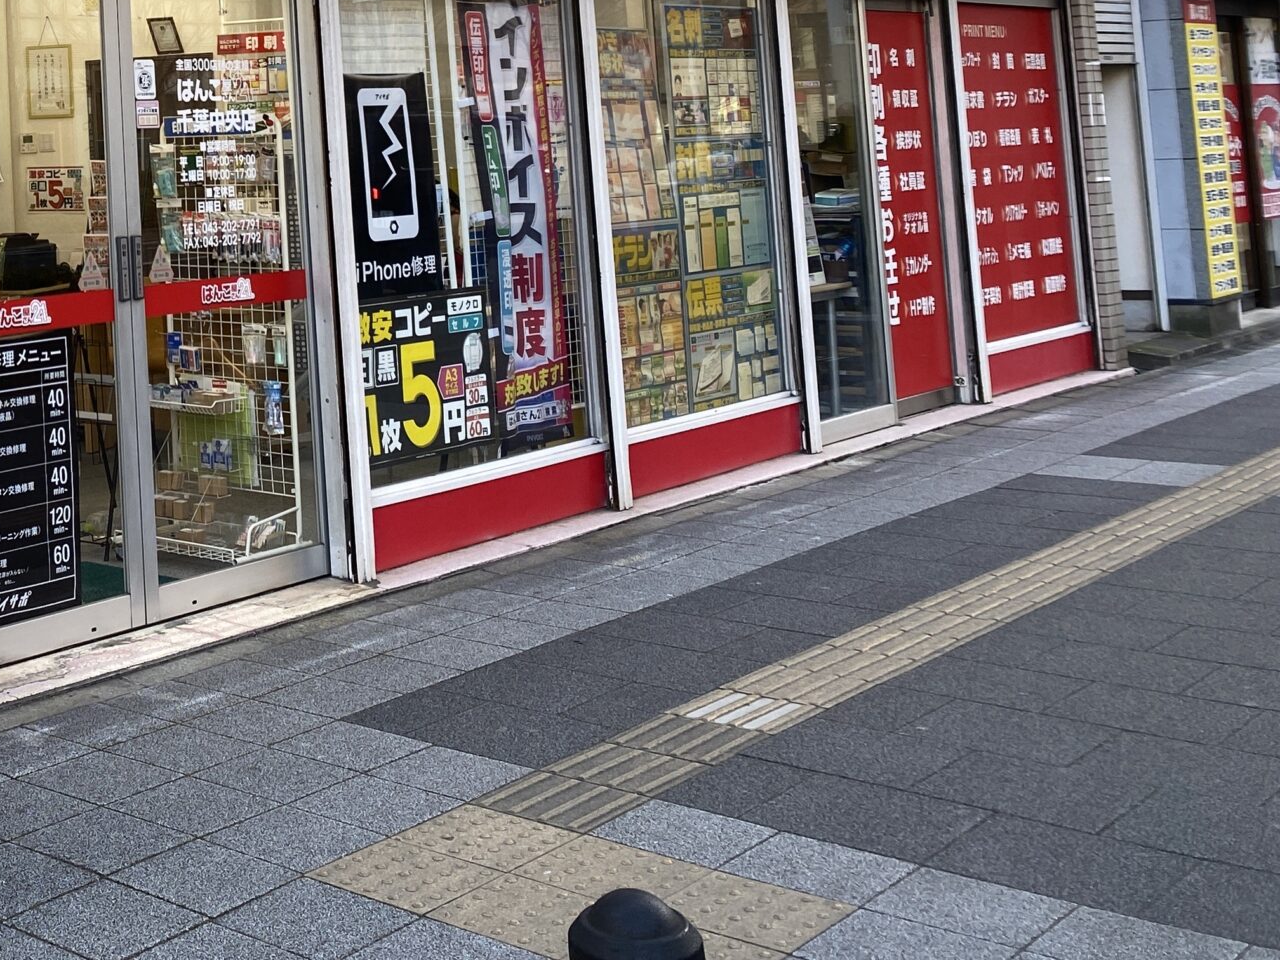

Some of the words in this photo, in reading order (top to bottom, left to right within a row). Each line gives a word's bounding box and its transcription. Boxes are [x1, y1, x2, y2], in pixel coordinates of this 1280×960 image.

[667, 8, 702, 48] 名刺
[995, 91, 1017, 108] チラシ
[177, 108, 257, 133] 千葉中央店
[676, 141, 713, 179] 封筒
[180, 170, 203, 182] 土曜日
[494, 15, 548, 358] インボイス制度
[613, 234, 652, 271] チラシ
[451, 300, 479, 311] モノクロ
[686, 276, 723, 320] 伝票
[451, 317, 479, 328] セルフ
[17, 349, 61, 366] メニュー
[445, 369, 458, 382] A3
[48, 388, 64, 408] 40
[49, 426, 66, 446] 40
[51, 466, 67, 486] 40
[50, 505, 71, 526] 120
[54, 544, 70, 565] 60
